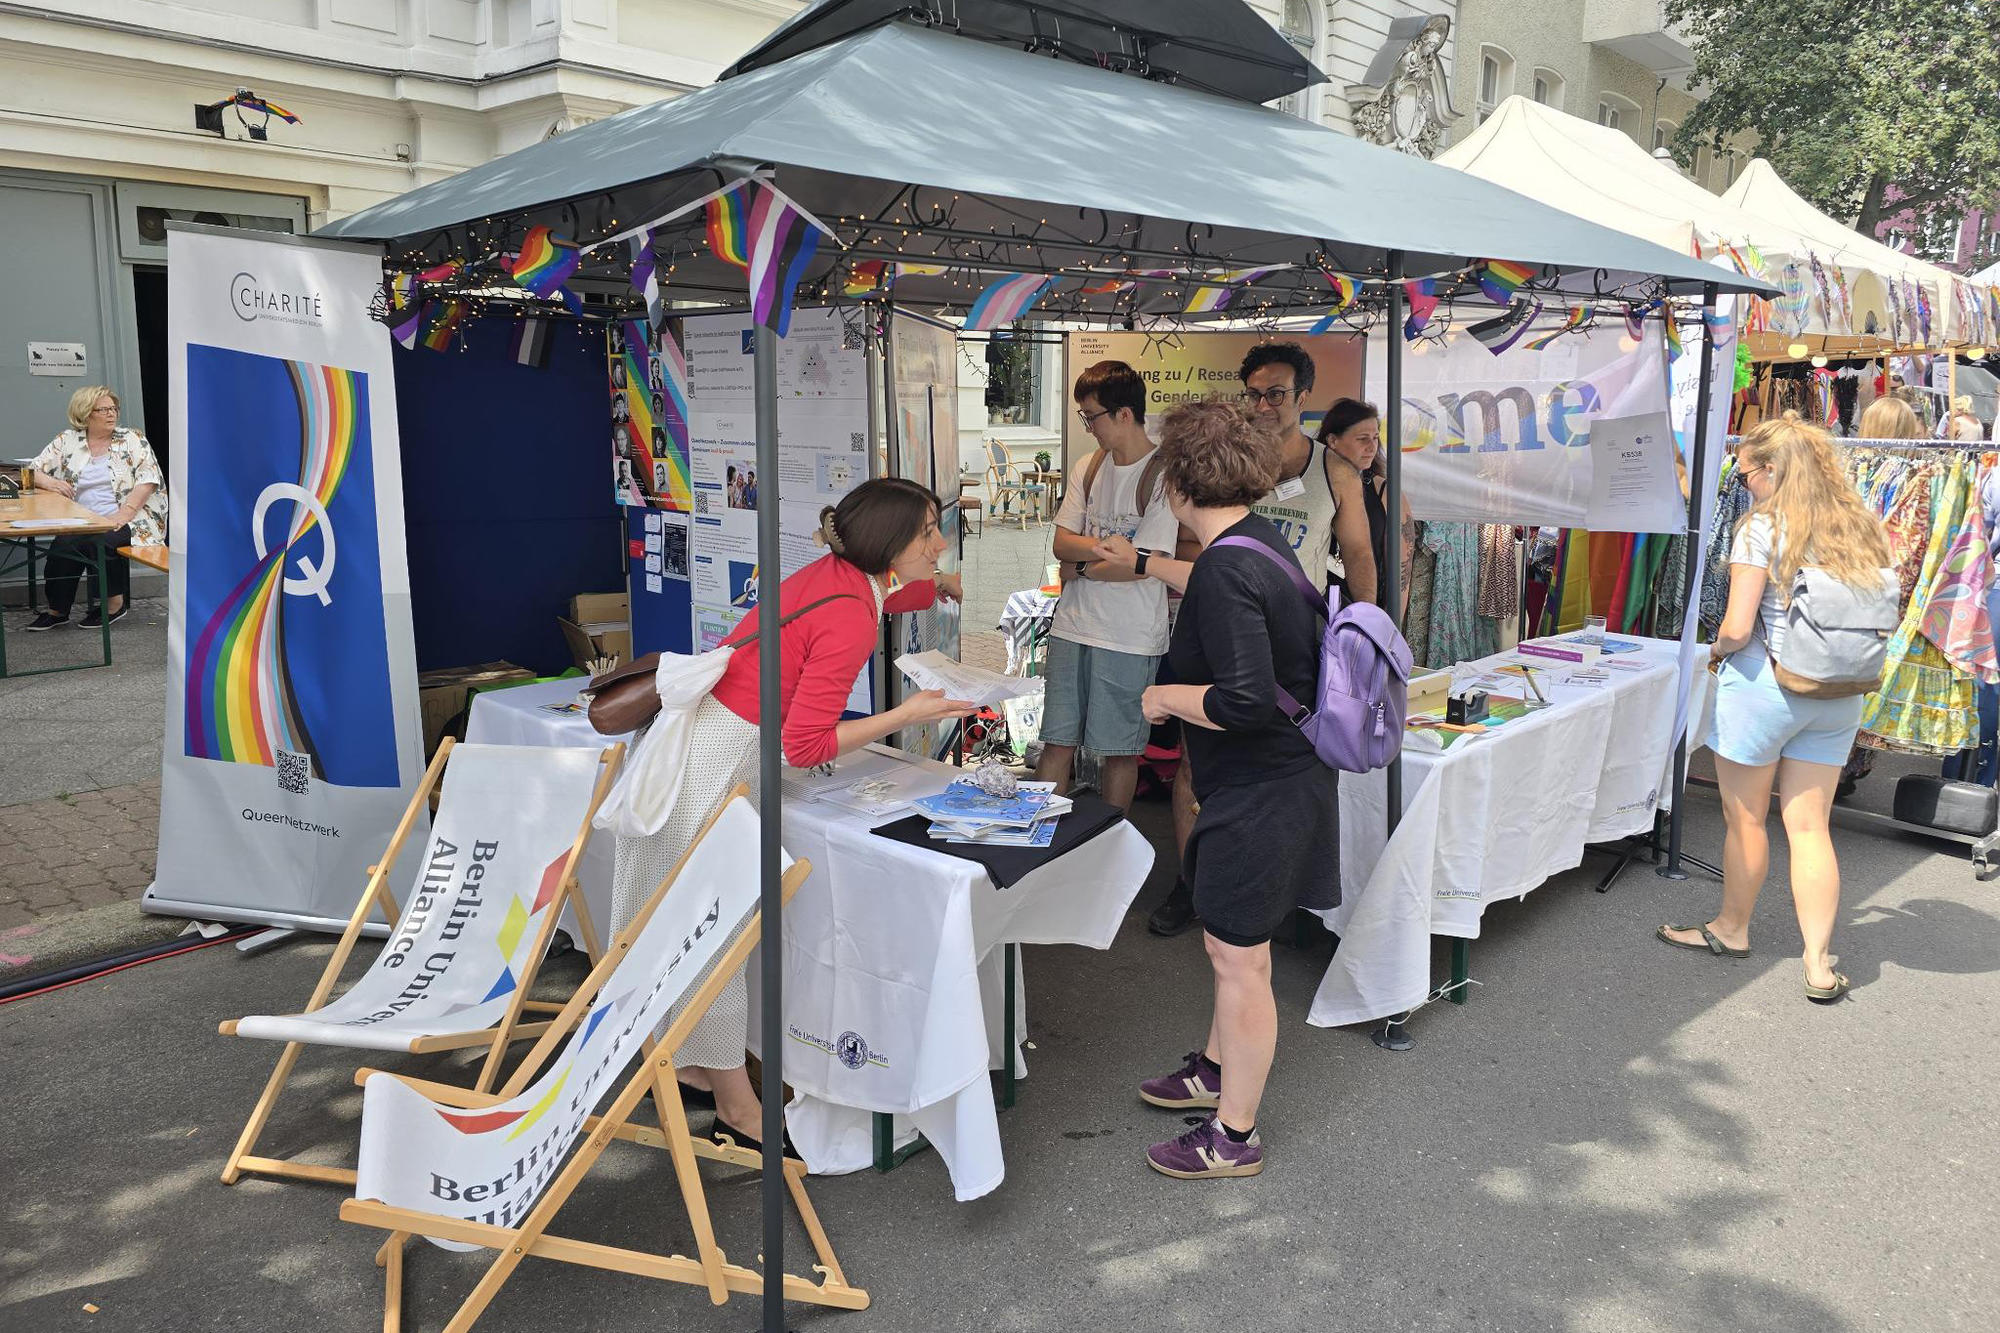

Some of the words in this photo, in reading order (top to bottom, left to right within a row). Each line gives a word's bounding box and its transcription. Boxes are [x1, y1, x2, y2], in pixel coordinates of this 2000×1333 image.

[238, 286, 322, 318] CHARITÉ
[1151, 390, 1207, 403] Gender
[1165, 371, 1181, 380] zu
[1186, 366, 1194, 383] /
[1198, 368, 1241, 381] Resea
[1380, 380, 1602, 454] ome
[1250, 505, 1269, 513] EVER
[1270, 506, 1308, 520] SURRENDER
[253, 482, 333, 607] Q
[242, 808, 340, 838] QueerNetzwerk
[384, 836, 458, 969] Alliance
[439, 839, 499, 942] Berlin
[430, 1125, 559, 1202] Berlin
[571, 897, 720, 1112] University
[789, 1024, 802, 1038] Freie
[803, 1031, 836, 1052] Universität
[868, 1050, 889, 1064] Berlin
[463, 1108, 586, 1229] liance
